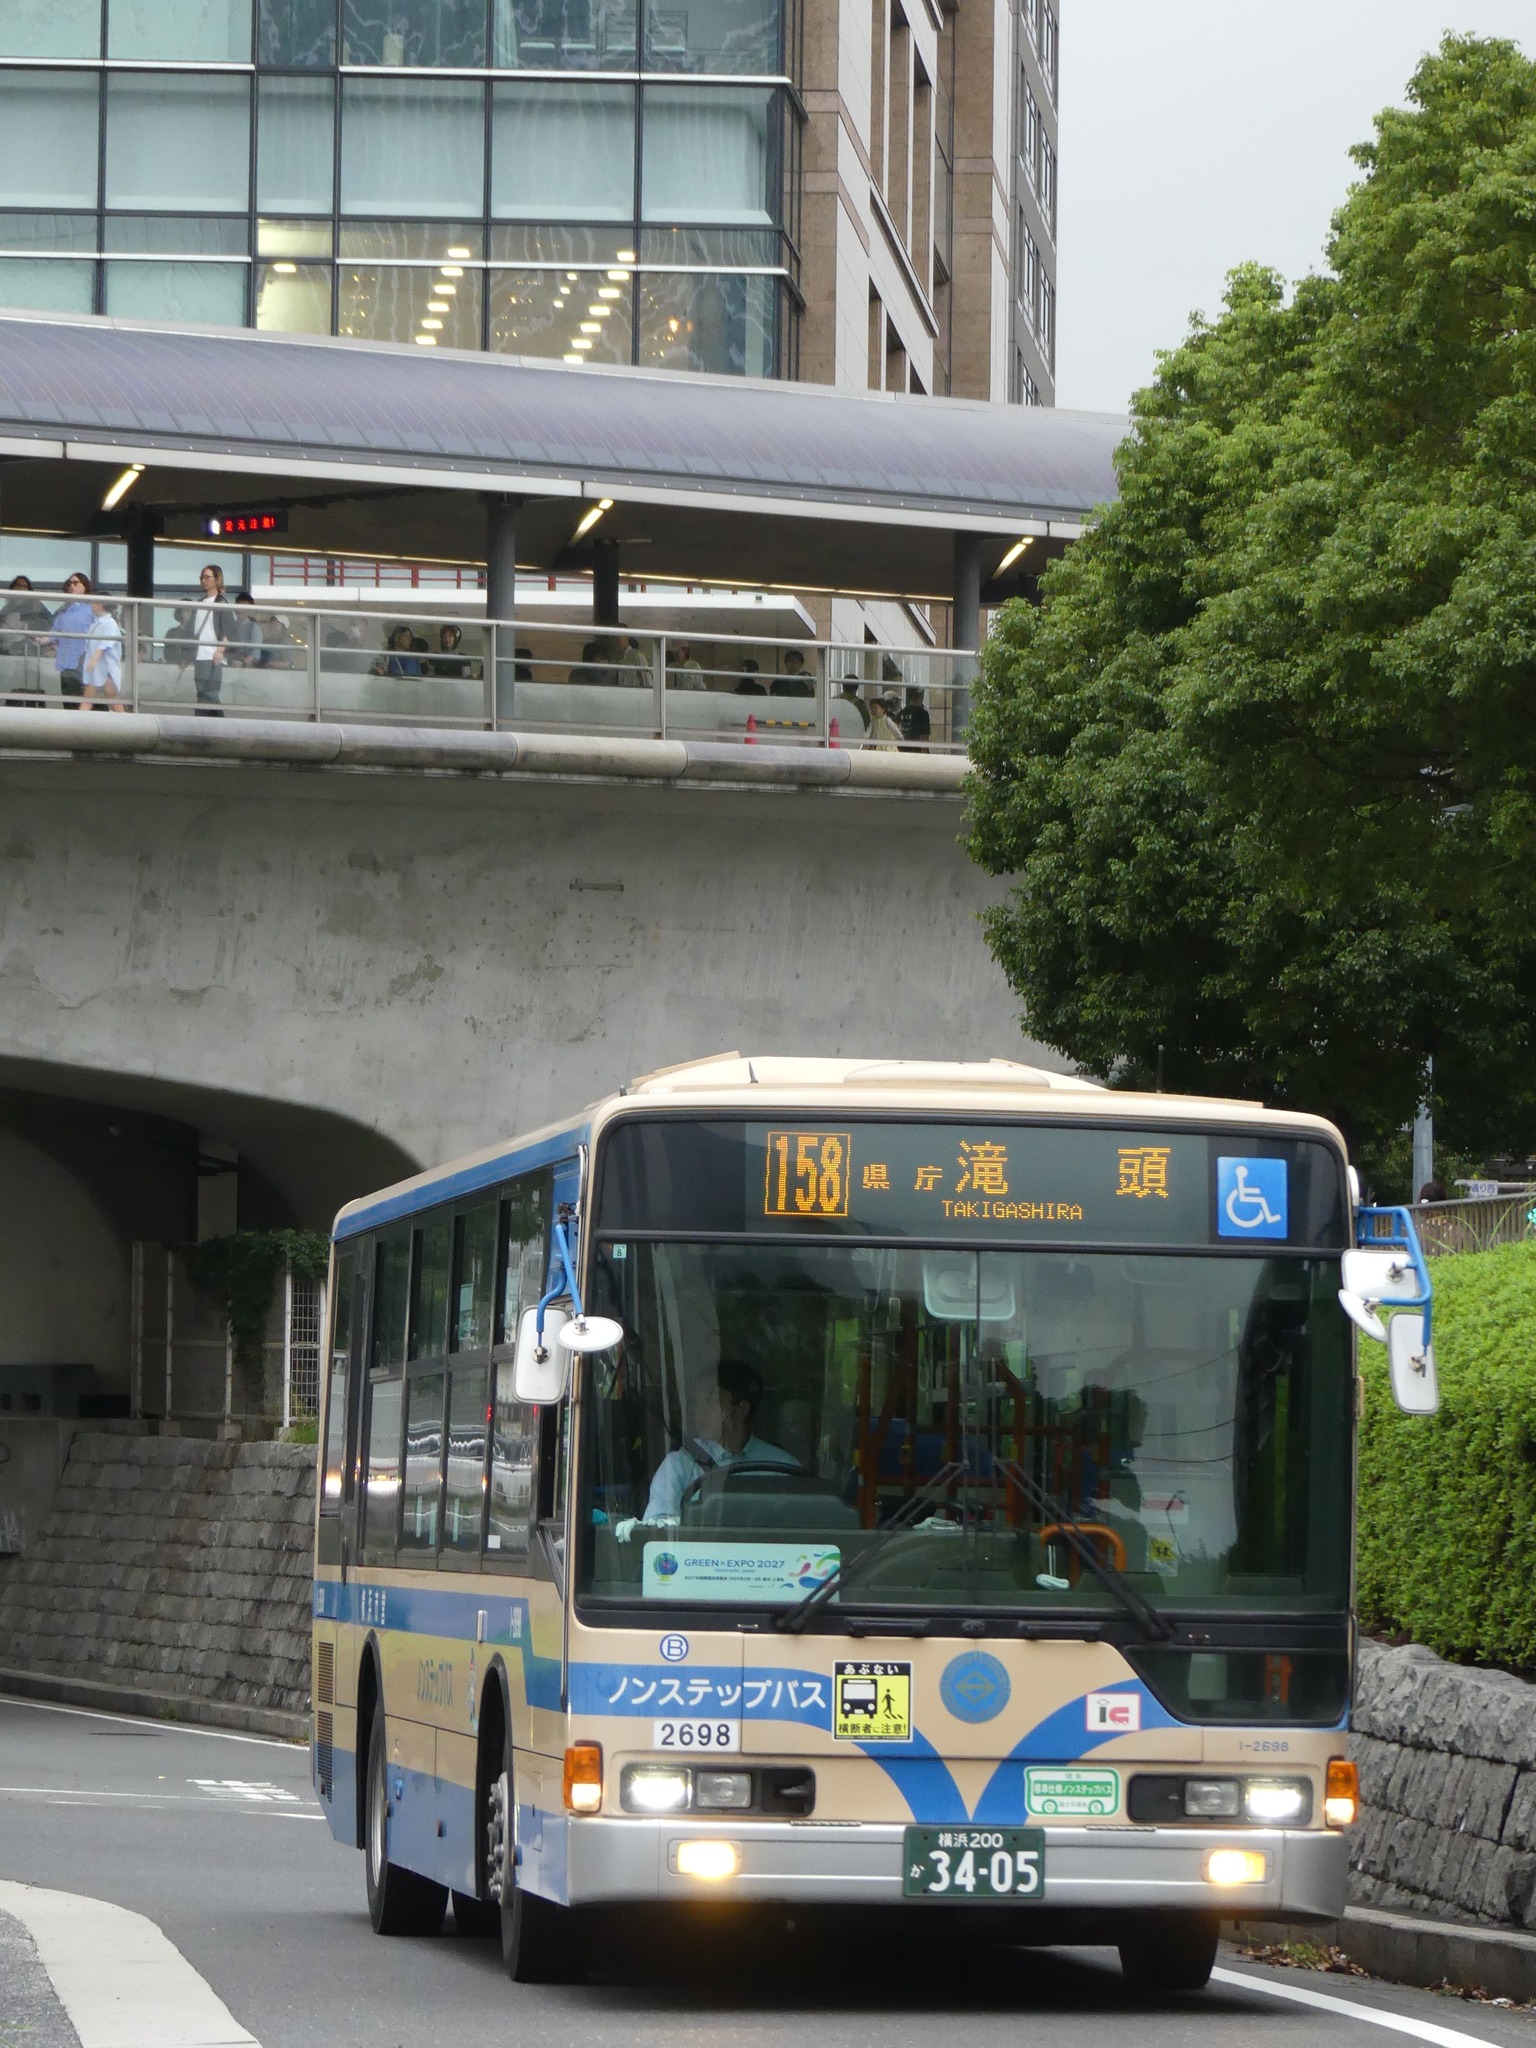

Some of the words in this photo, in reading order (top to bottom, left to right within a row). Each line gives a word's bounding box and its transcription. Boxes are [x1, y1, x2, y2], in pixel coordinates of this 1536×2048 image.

[776, 1136, 843, 1212] 158
[863, 1164, 943, 1190] 県庁
[955, 1141, 1171, 1198] 滝頭
[942, 1200, 1083, 1220] TAKIGASHIRA
[757, 1559, 785, 1569] 2027
[667, 1638, 684, 1657] B
[844, 1663, 900, 1675] あぶない
[608, 1676, 827, 1709] ノンステップバス
[661, 1723, 731, 1747] 2698
[838, 1723, 907, 1735] 横断者に注意!
[910, 1864, 925, 1879] か
[928, 1850, 1039, 1893] 34-05
